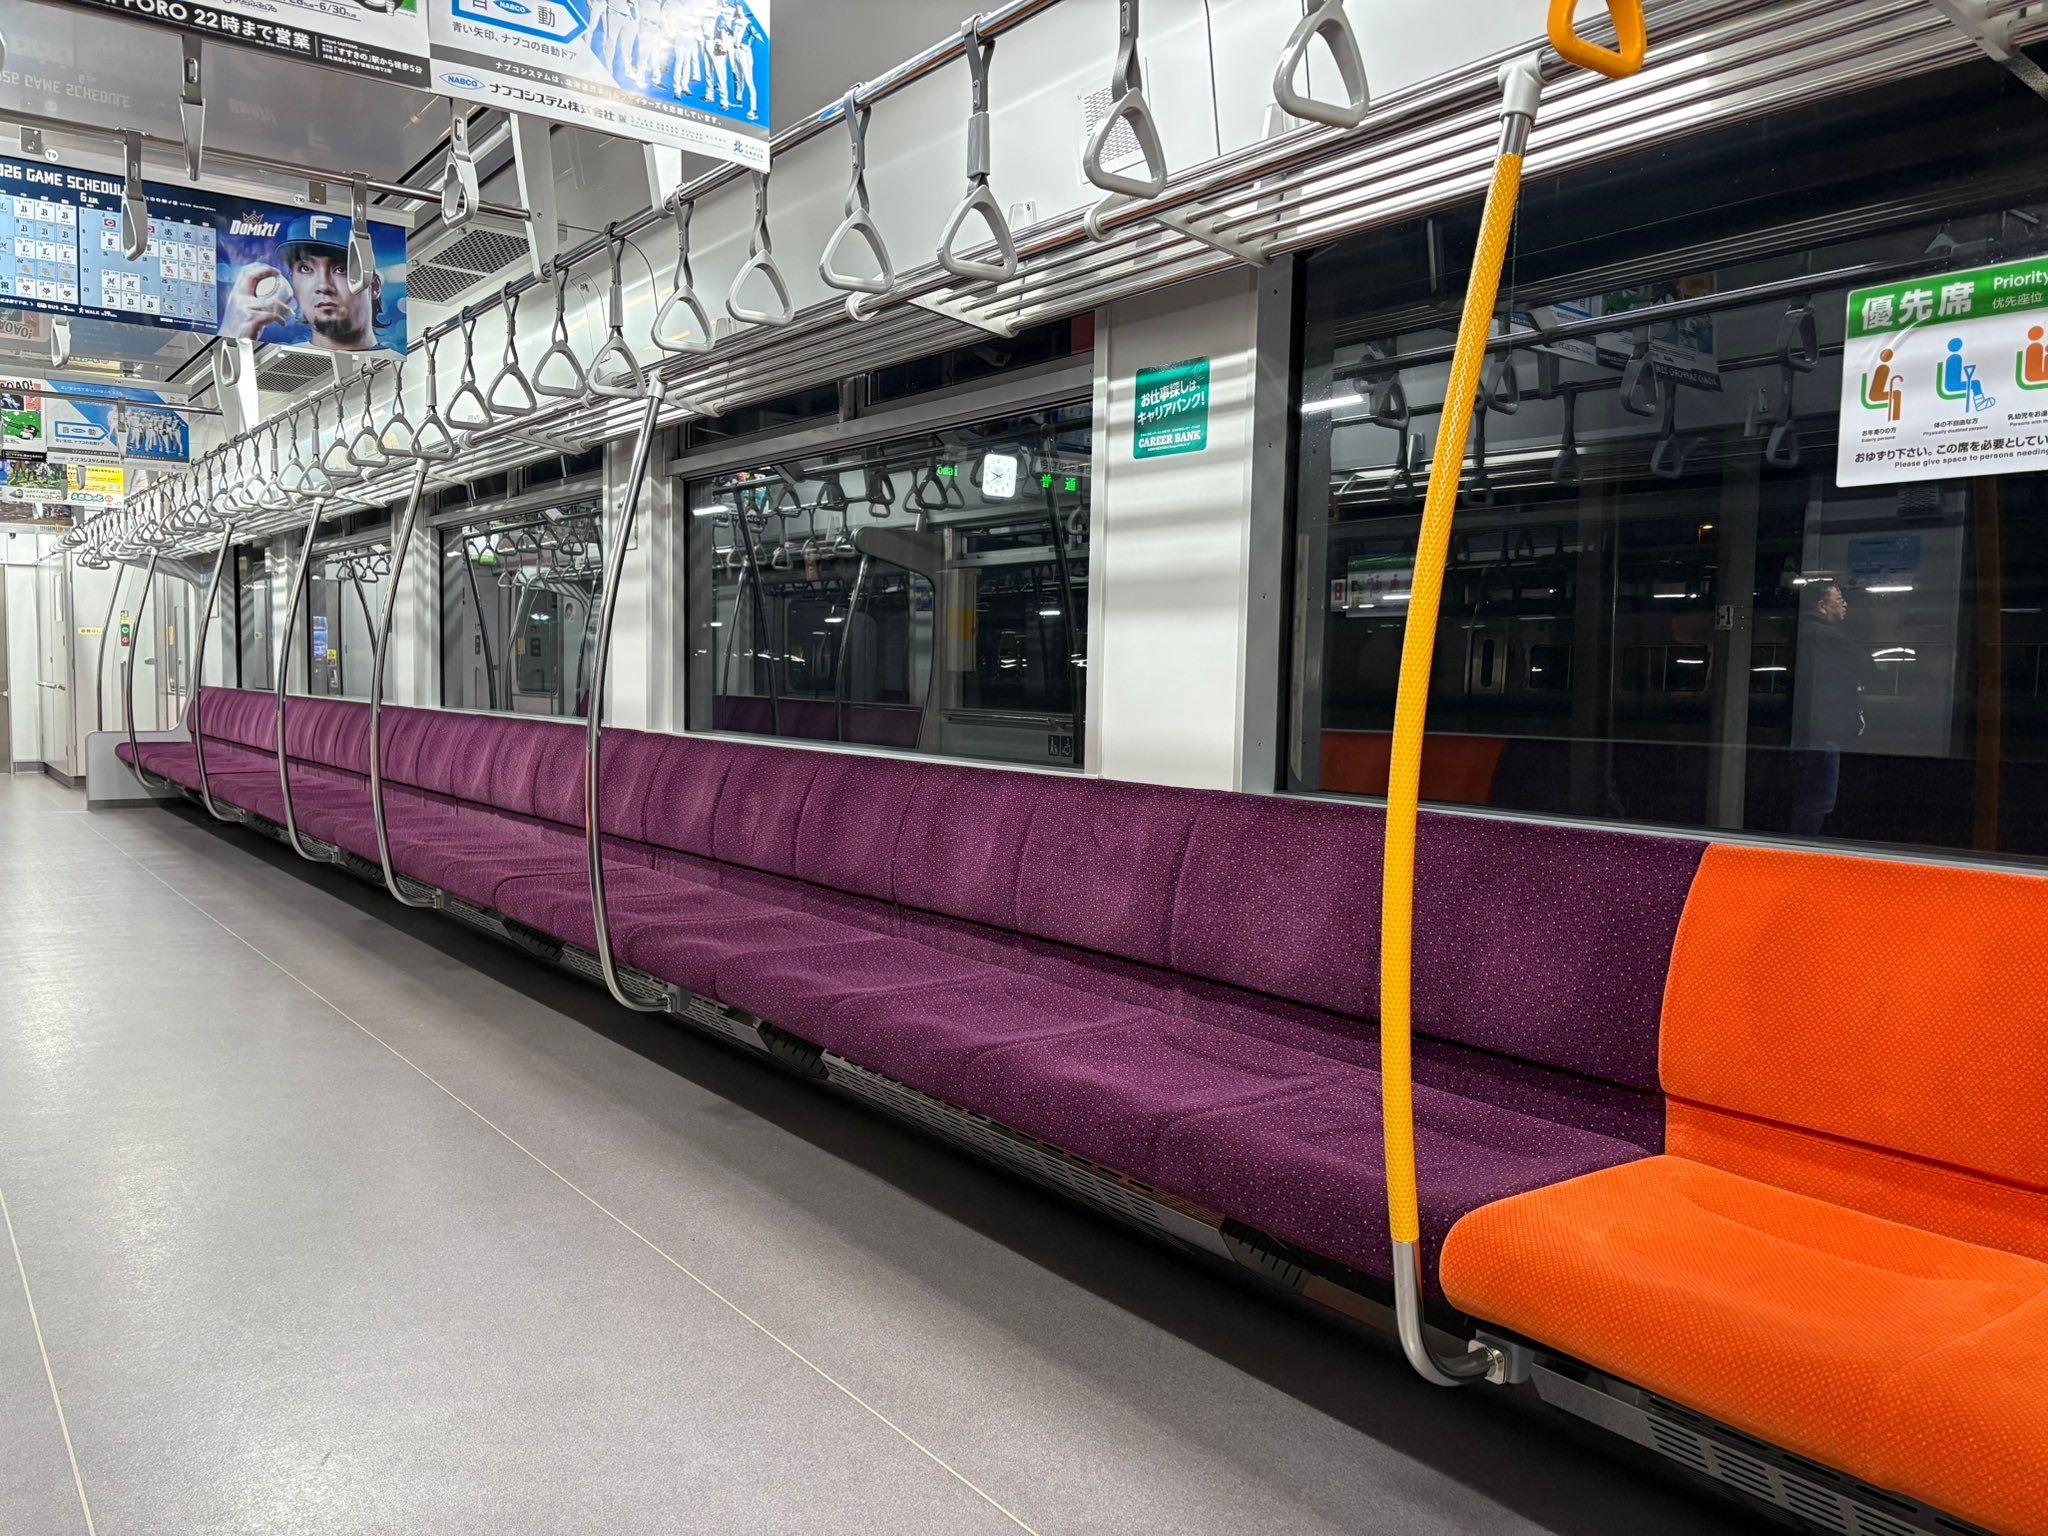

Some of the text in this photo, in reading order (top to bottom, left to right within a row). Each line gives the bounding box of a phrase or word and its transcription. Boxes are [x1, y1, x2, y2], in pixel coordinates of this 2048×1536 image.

[499, 0, 526, 13] NABCO
[538, 5, 556, 28] 動
[194, 9, 312, 50] 22時まで営業
[452, 21, 577, 60] 青い矢印、ナブコの自動ドア
[447, 75, 478, 88] NABCO
[27, 168, 63, 187] GAME
[66, 175, 126, 196] SCHEDUL
[80, 192, 87, 202] 6
[310, 215, 333, 240] F
[1993, 270, 2048, 290] Priority
[1862, 281, 1975, 330] 優先席
[1992, 291, 2043, 309] 优先座位
[1141, 380, 1200, 408] お仕事探しは、
[1137, 391, 1205, 426] キャリアバンク!
[1933, 417, 1979, 429] 体の不自由な方
[1139, 433, 1173, 448] CAREER
[1175, 430, 1201, 443] BANK
[1894, 460, 1921, 469] Please
[1922, 457, 1941, 467] give
[1942, 455, 1967, 465] space
[1979, 451, 2014, 462] persons
